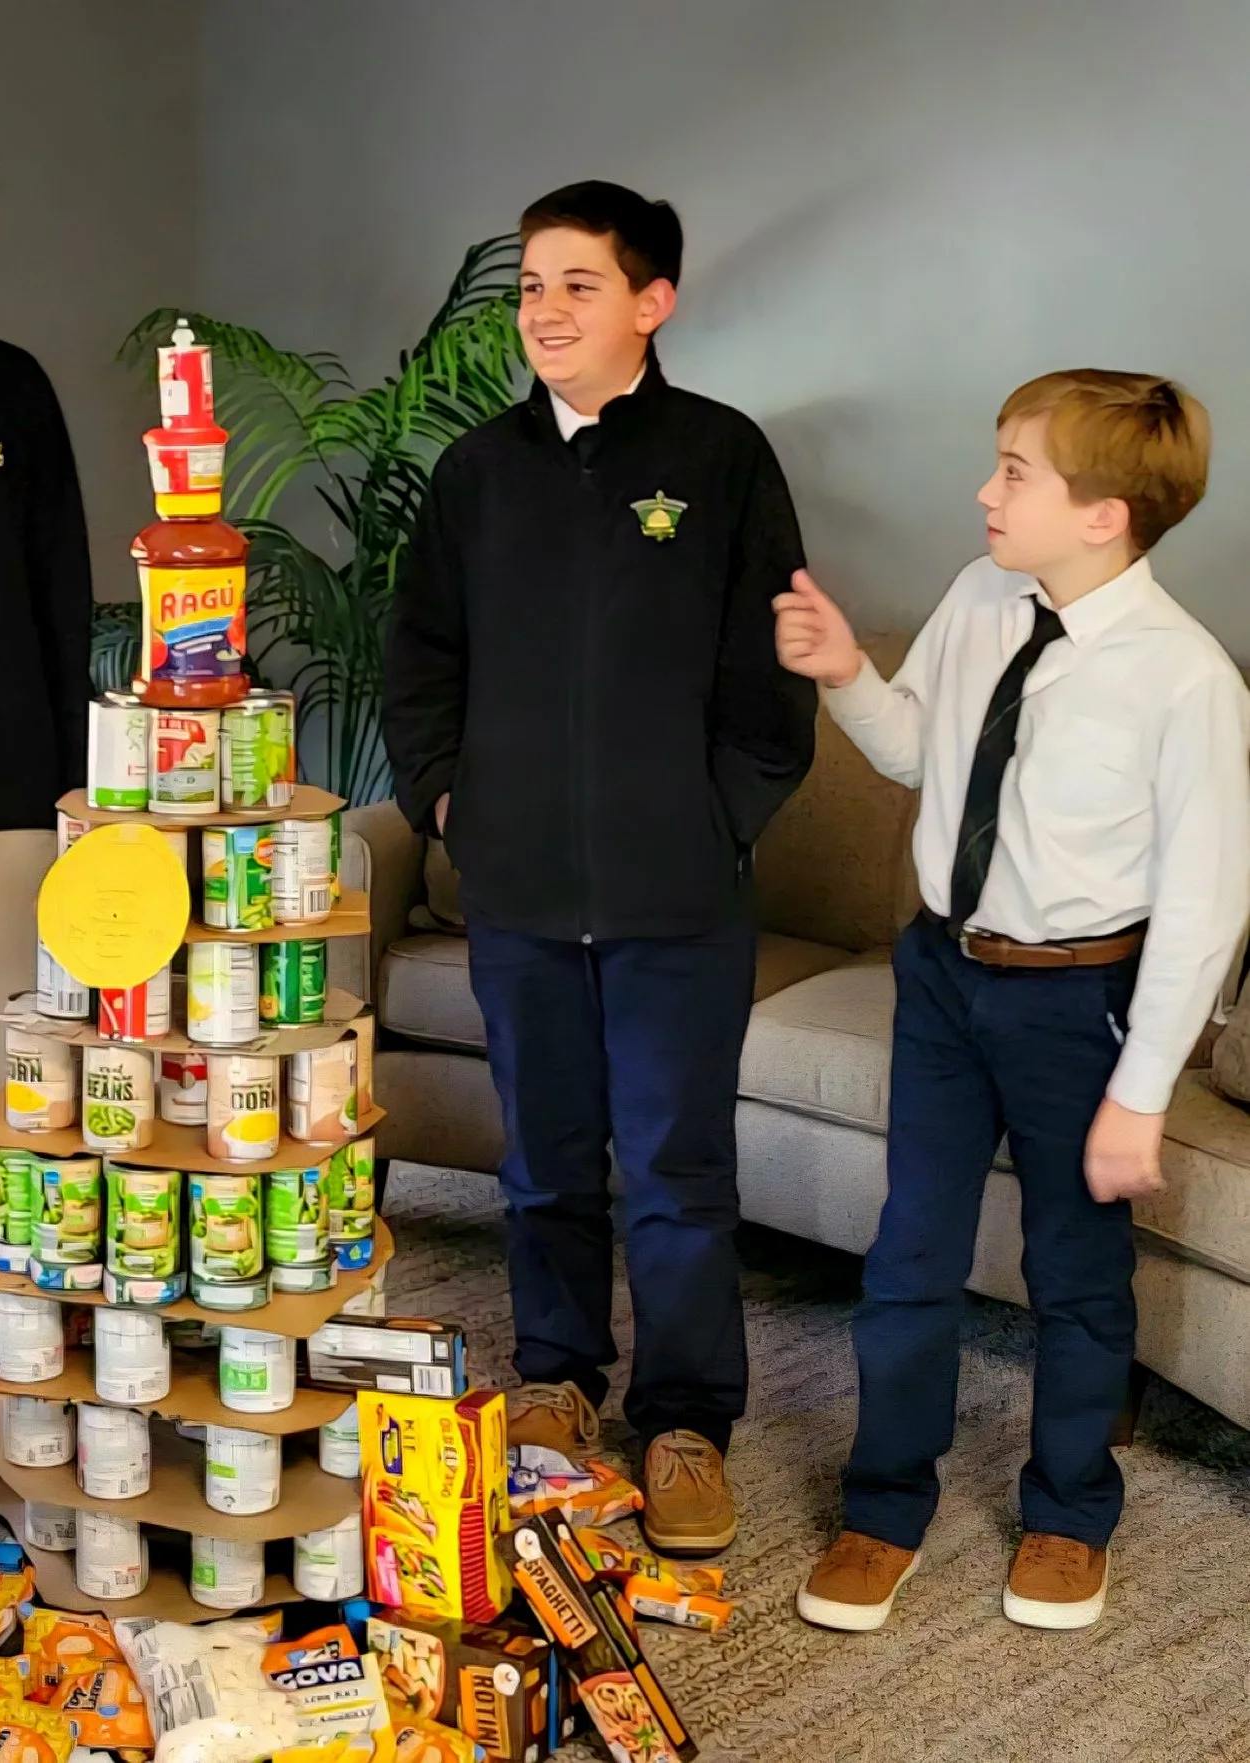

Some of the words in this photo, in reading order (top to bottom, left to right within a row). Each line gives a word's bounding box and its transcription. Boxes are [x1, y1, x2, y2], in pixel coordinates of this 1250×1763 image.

[8, 1059, 42, 1082] ORN
[524, 1560, 586, 1640] SPAGHETTI
[472, 1674, 501, 1749] ROTINI
